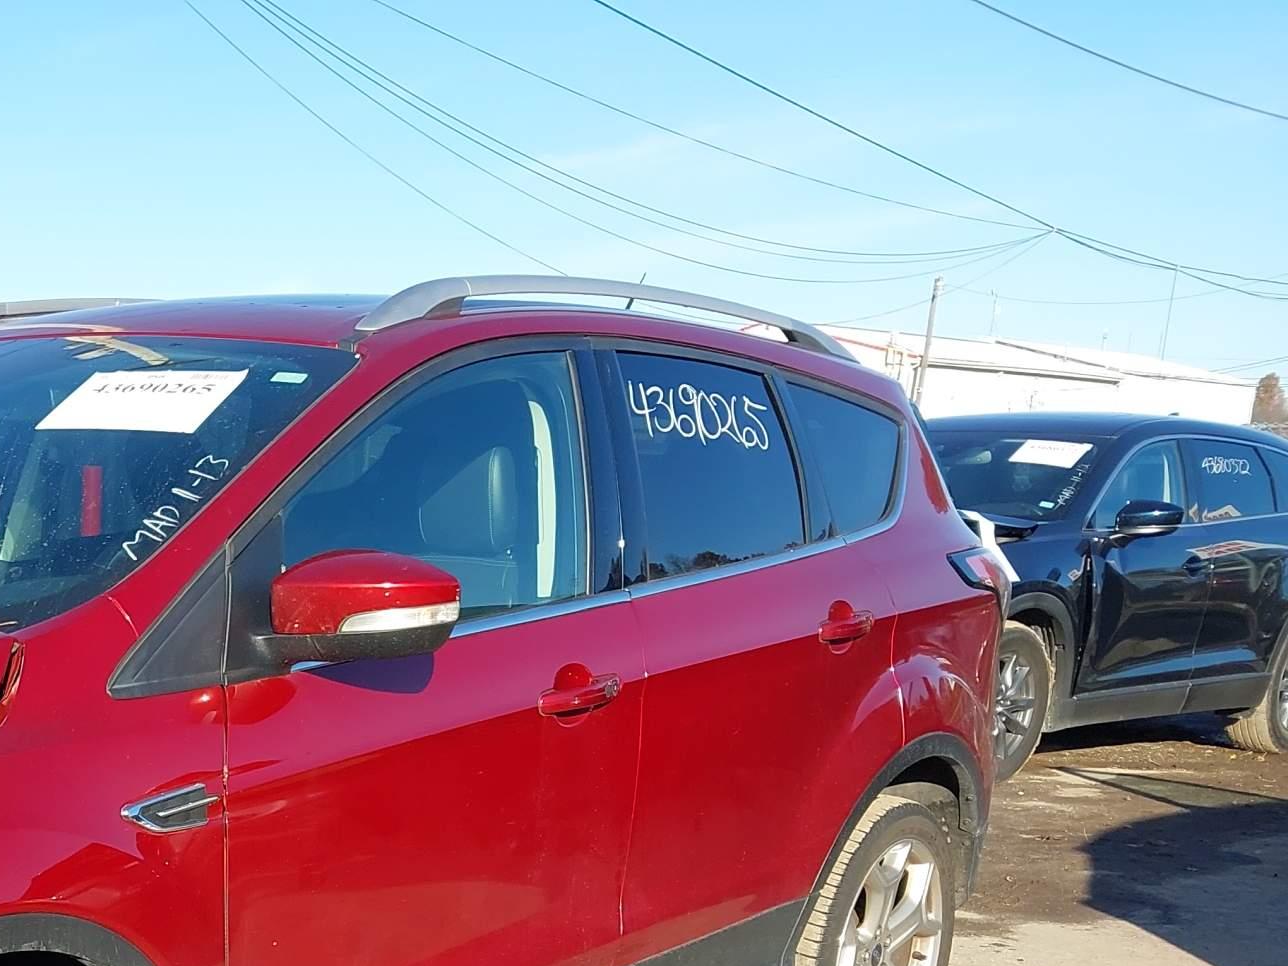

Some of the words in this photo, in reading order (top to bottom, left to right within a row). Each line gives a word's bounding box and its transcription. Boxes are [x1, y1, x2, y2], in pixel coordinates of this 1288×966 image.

[92, 382, 217, 395] 43690265
[627, 380, 769, 450] 43690265
[122, 505, 181, 561] MAD
